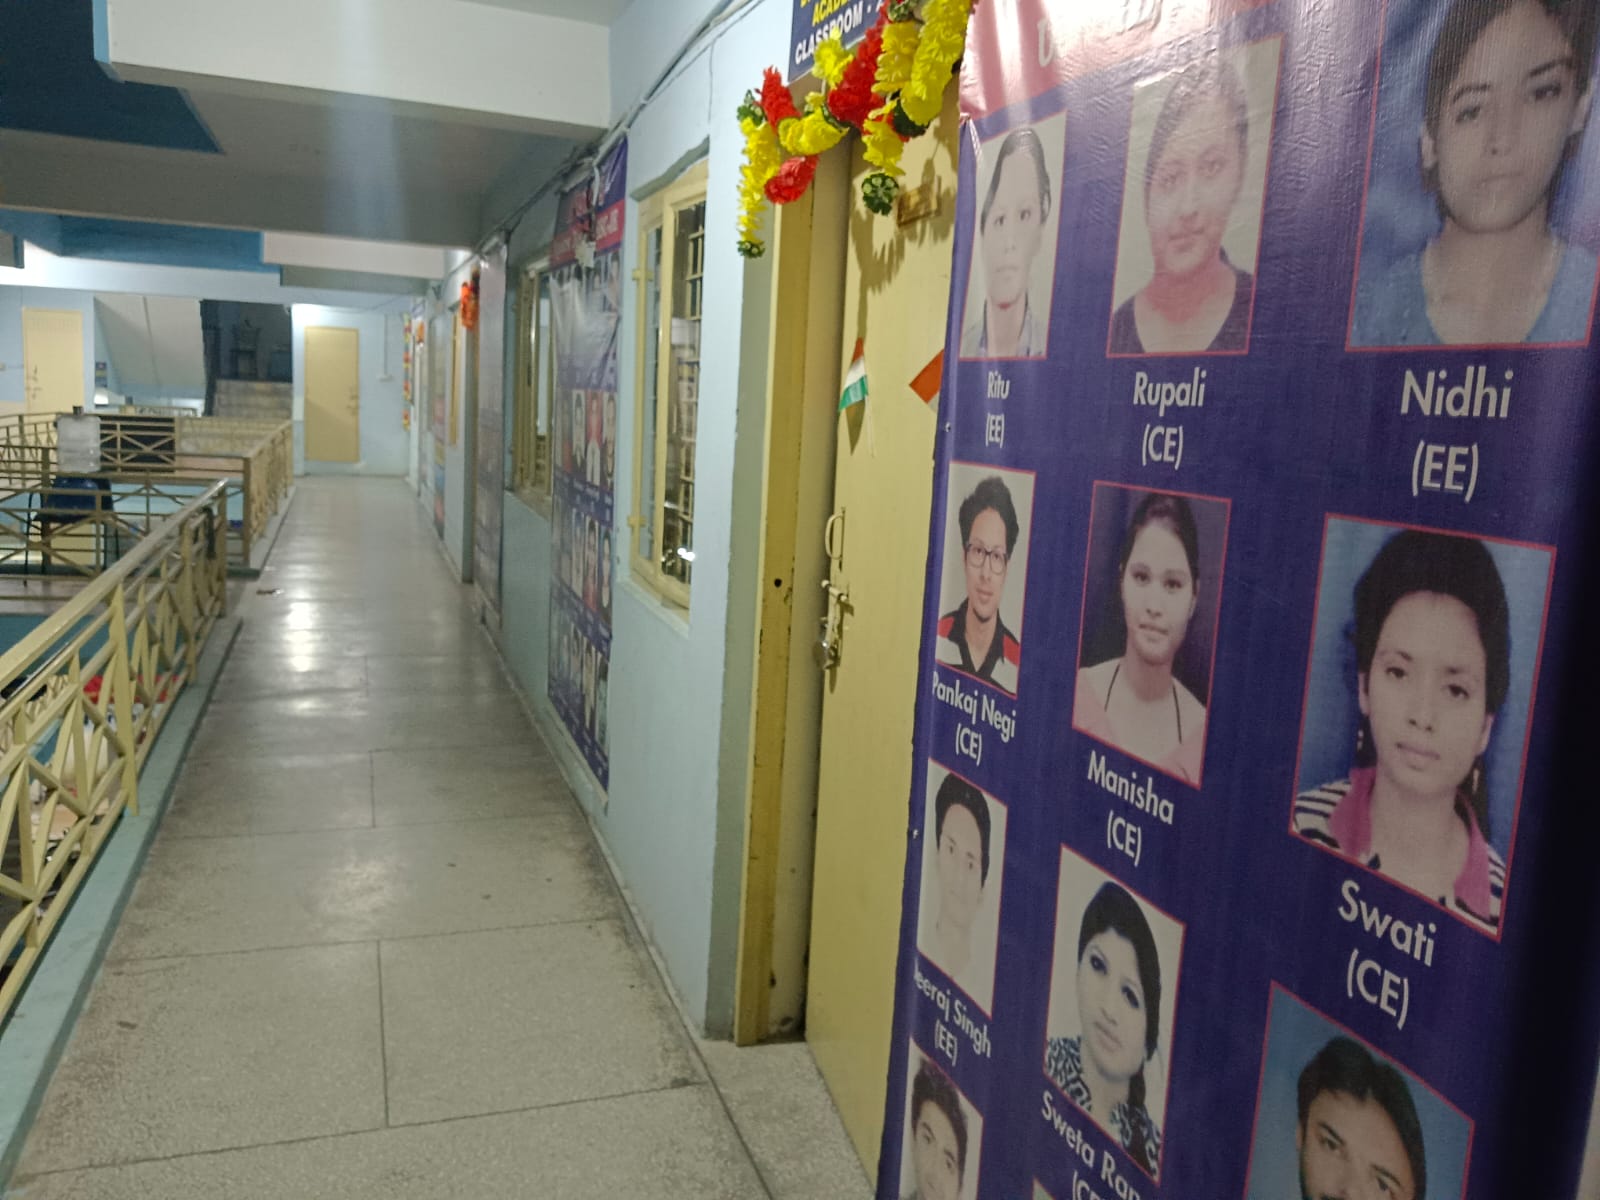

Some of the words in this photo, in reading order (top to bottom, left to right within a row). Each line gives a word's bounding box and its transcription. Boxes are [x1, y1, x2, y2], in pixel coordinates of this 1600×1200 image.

[987, 370, 1011, 399] Ritu
[1133, 367, 1207, 417] Rupali
[1400, 365, 1514, 418] Nidhi
[985, 412, 1005, 449] (EE)
[1142, 424, 1184, 470] (CE)
[1412, 440, 1480, 503] (EE)
[932, 671, 978, 725] Pankaj
[981, 693, 1017, 743] Negi
[955, 722, 983, 767] (CE)
[1087, 749, 1175, 825] Manisha
[1107, 810, 1142, 867] (CE)
[1337, 879, 1437, 968] Swati
[1347, 947, 1409, 1031] (CE)
[935, 1018, 958, 1067] (EE)
[953, 998, 992, 1059] Singh
[1041, 1089, 1095, 1169] Sweta
